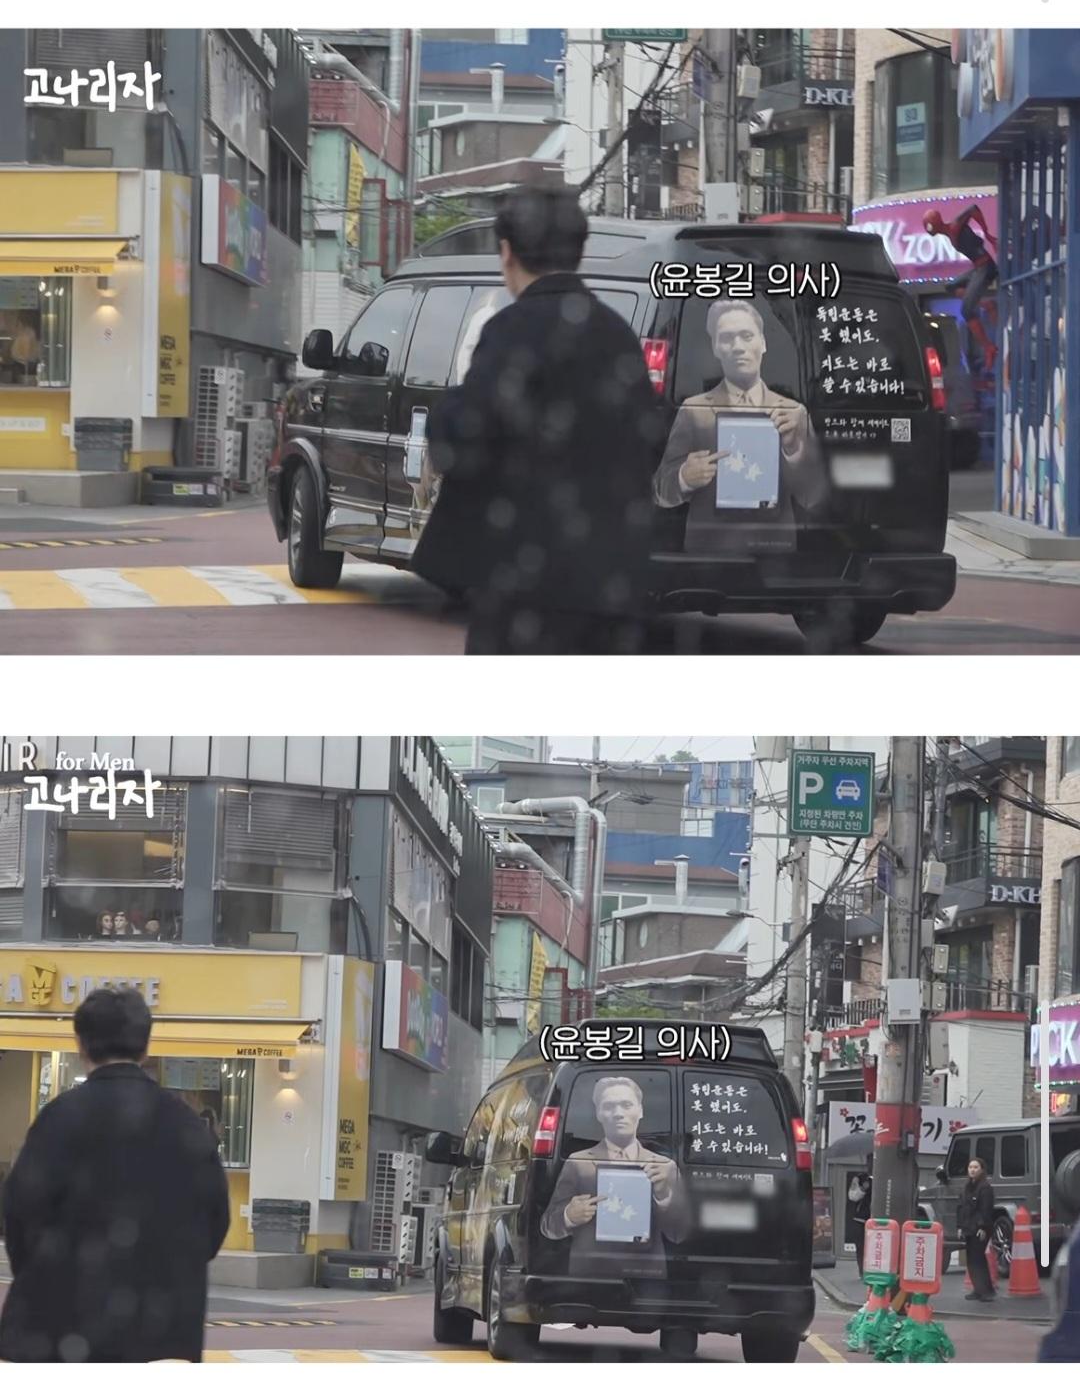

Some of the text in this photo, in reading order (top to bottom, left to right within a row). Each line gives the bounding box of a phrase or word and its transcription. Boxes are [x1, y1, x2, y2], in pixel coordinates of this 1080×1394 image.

[816, 306, 878, 322] 독립운동은
[819, 327, 832, 342] 못
[821, 354, 892, 372] 지도는 바로
[56, 752, 85, 771] for
[90, 752, 135, 771] Men
[798, 756, 869, 767] 거주자 우선 주차지역
[799, 771, 824, 805] P
[799, 809, 864, 820] 지정된 차량만 주차
[820, 820, 843, 830] 주차시
[691, 1121, 757, 1137] 지도는 바로
